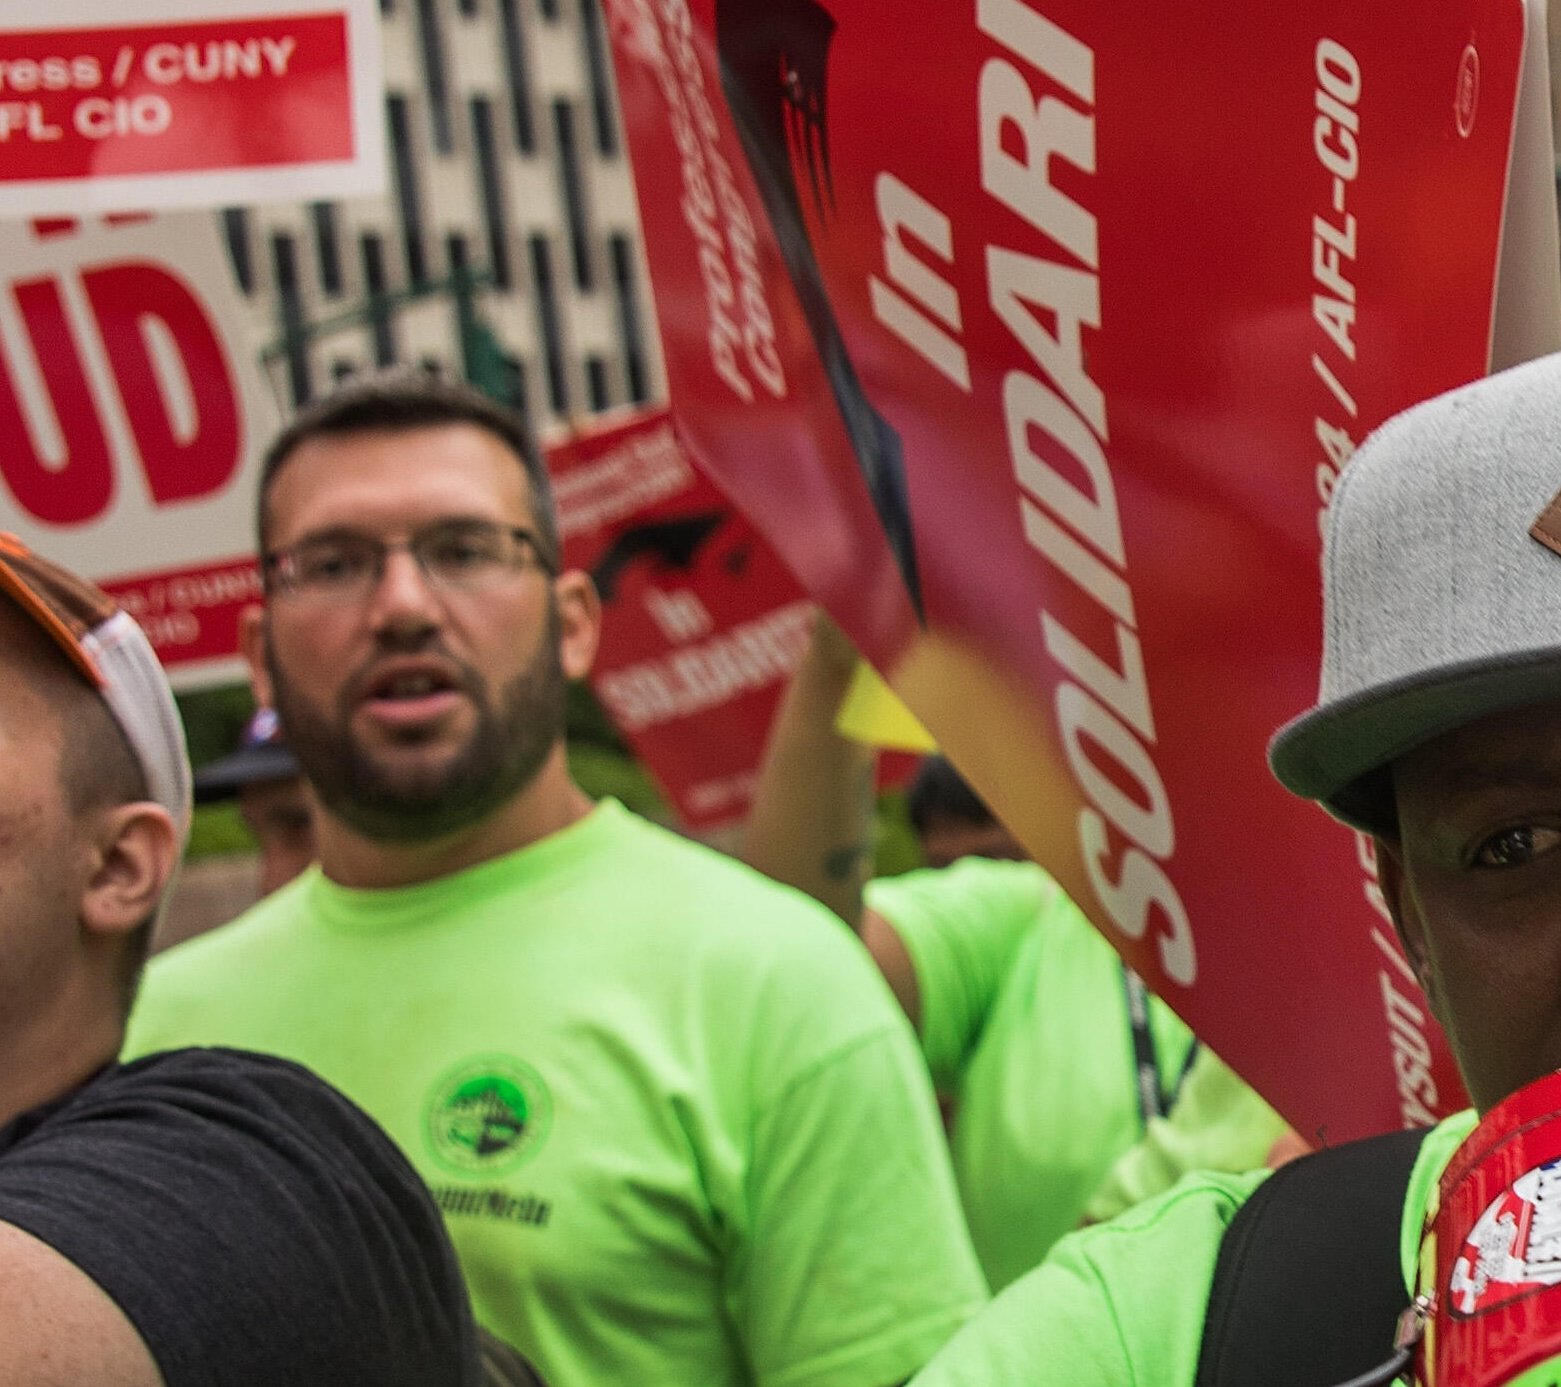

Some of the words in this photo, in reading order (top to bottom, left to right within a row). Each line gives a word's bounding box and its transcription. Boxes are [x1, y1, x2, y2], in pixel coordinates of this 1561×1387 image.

[73, 92, 172, 140] CIO
[143, 33, 296, 84] CUNY
[1312, 38, 1362, 362] AFL-CIO
[868, 172, 971, 394] In
[1380, 968, 1439, 1130] YSUT
